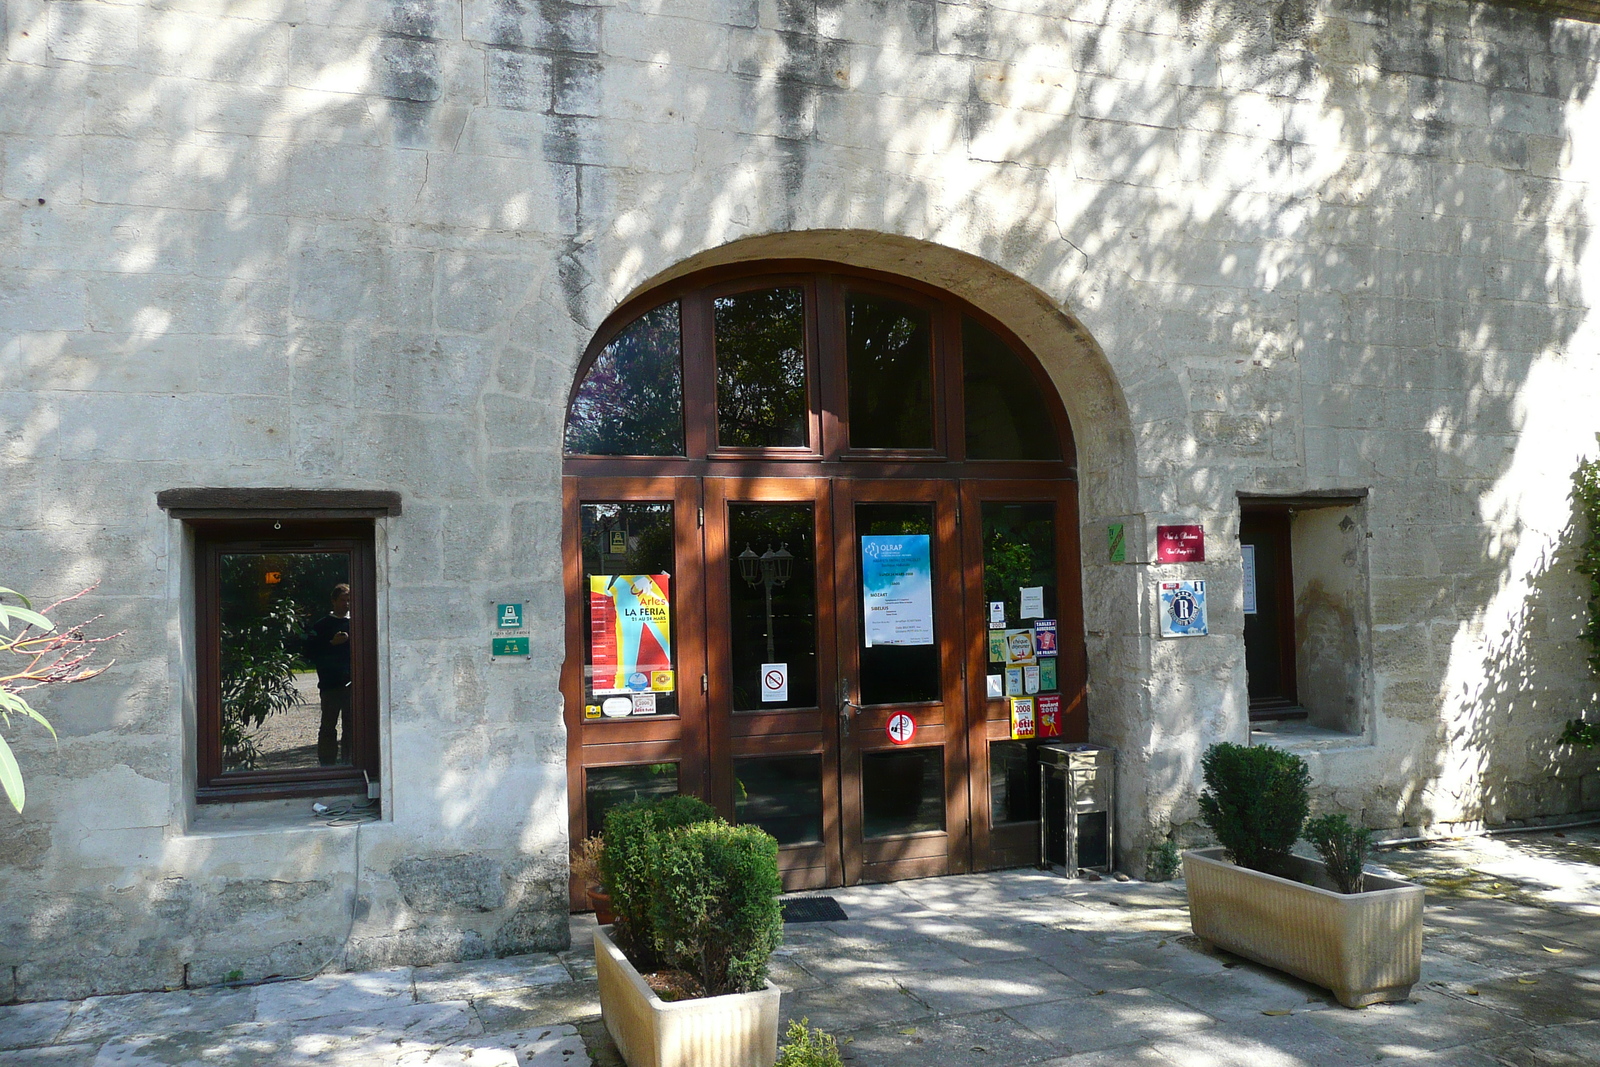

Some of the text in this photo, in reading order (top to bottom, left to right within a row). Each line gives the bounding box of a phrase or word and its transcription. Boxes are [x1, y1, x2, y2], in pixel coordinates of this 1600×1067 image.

[640, 597, 666, 606] Arles
[625, 608, 637, 616] LA
[1179, 599, 1189, 618] R
[1015, 705, 1031, 713] 2008
[1013, 719, 1034, 730] petit
